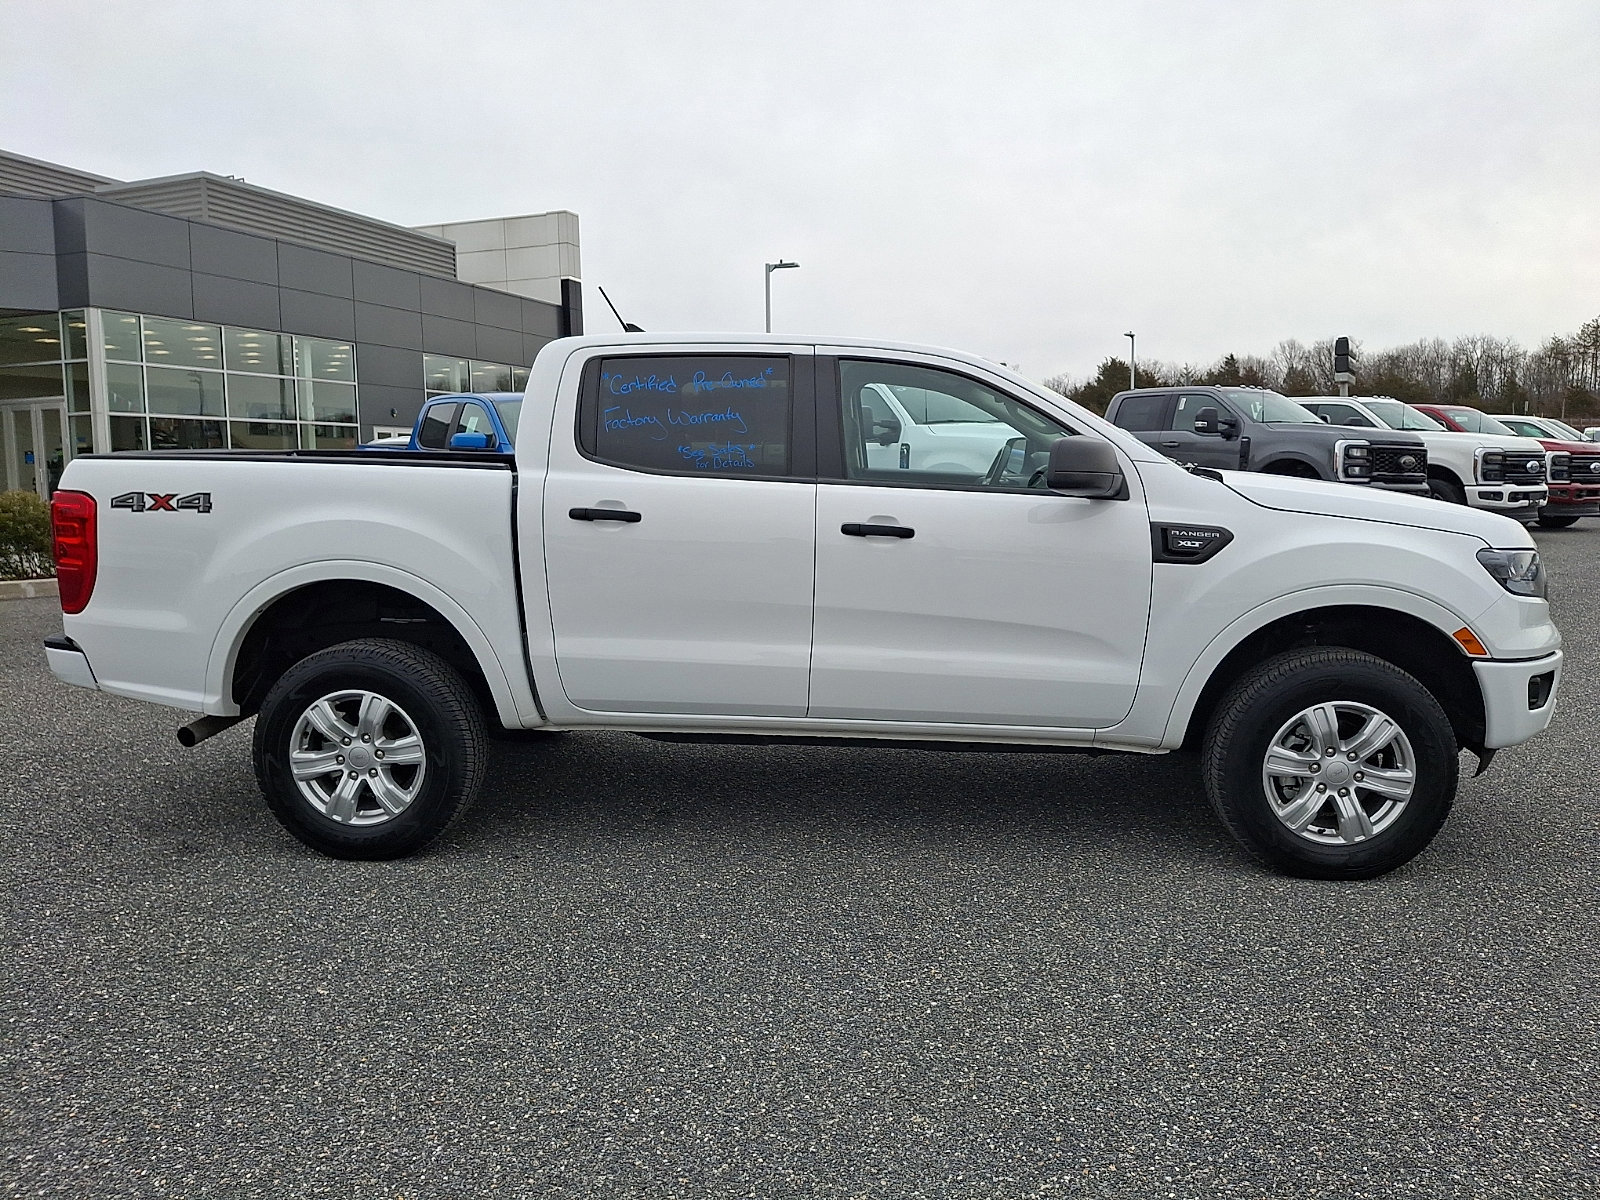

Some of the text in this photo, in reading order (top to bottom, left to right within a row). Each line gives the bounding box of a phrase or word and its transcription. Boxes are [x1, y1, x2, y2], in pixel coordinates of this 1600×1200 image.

[603, 406, 748, 440] Factory Warranty
[1171, 530, 1220, 538] RANGER
[1178, 540, 1203, 548] XLT
